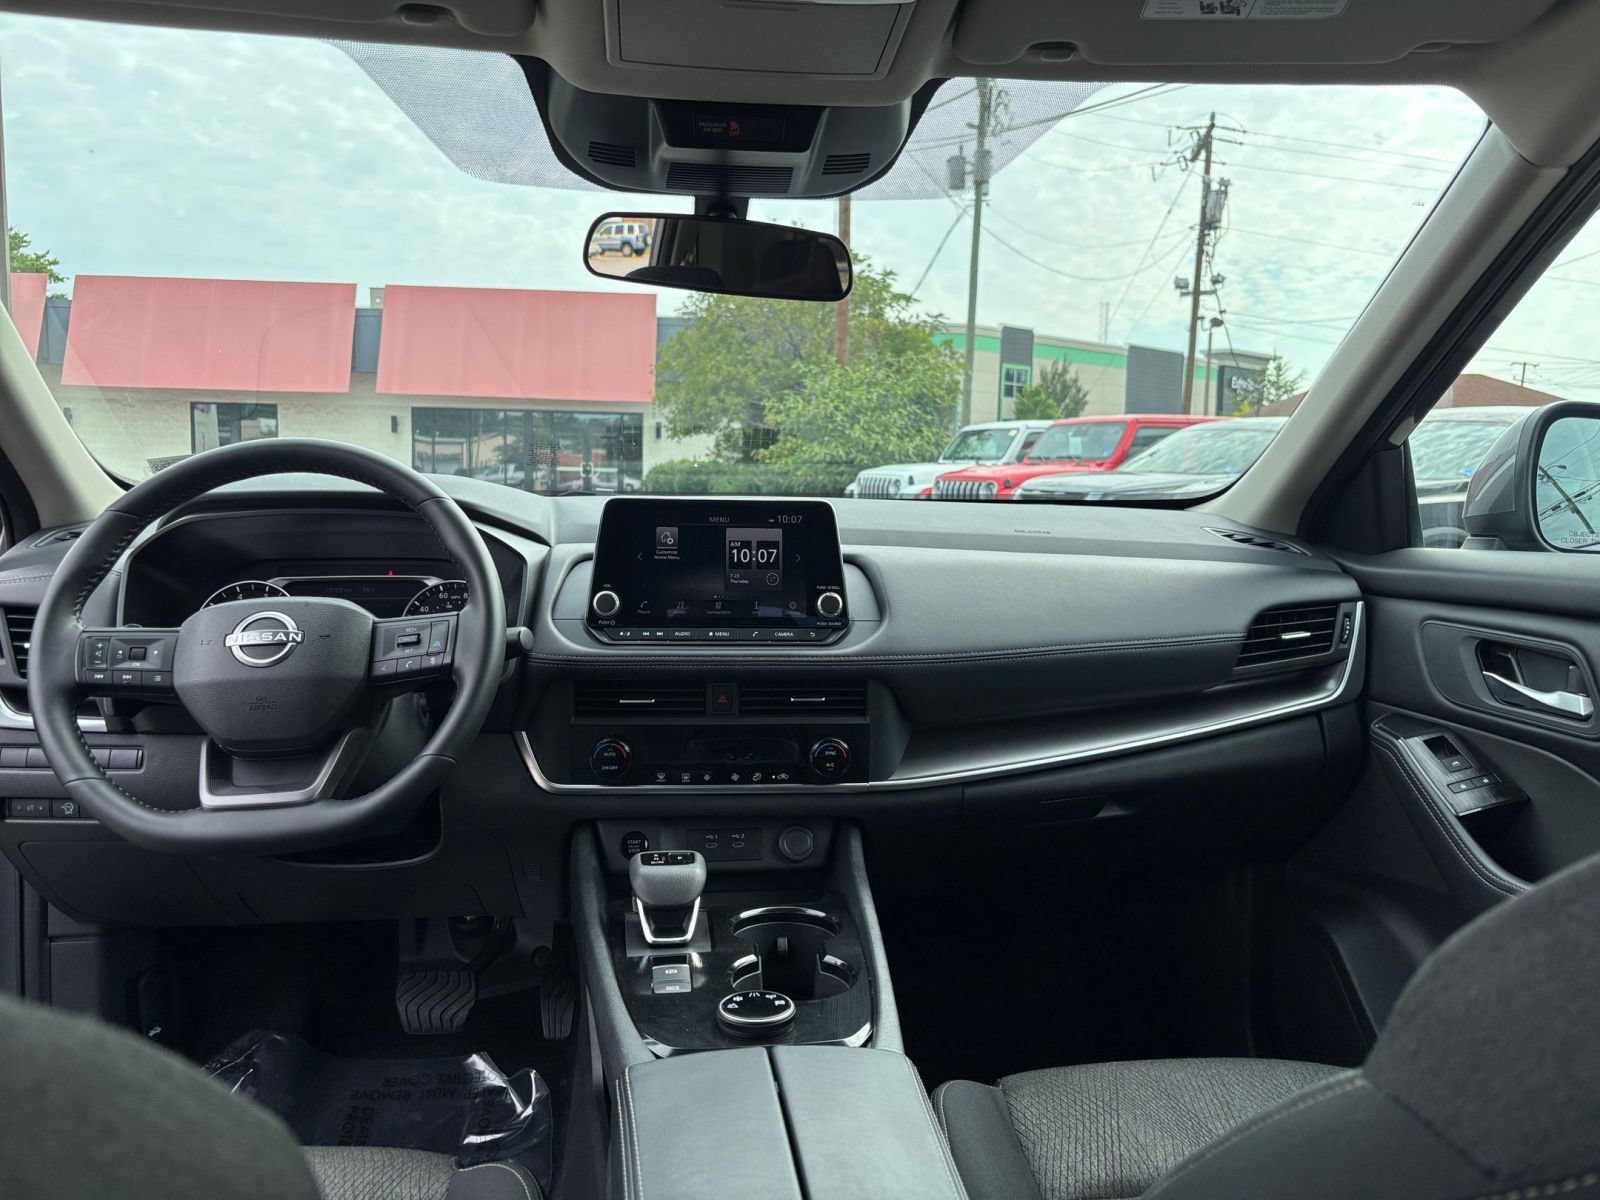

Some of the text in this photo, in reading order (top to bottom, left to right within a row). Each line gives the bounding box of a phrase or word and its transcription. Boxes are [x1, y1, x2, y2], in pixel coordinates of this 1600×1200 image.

[778, 515, 803, 524] 10:07
[1560, 536, 1587, 544] CLOSER
[731, 548, 777, 563] 10:07
[419, 605, 430, 613] 40
[228, 631, 303, 646] NISSAN
[381, 1072, 432, 1087] COVER
[349, 1088, 411, 1102] REMOVE
[420, 1087, 456, 1100] MUST
